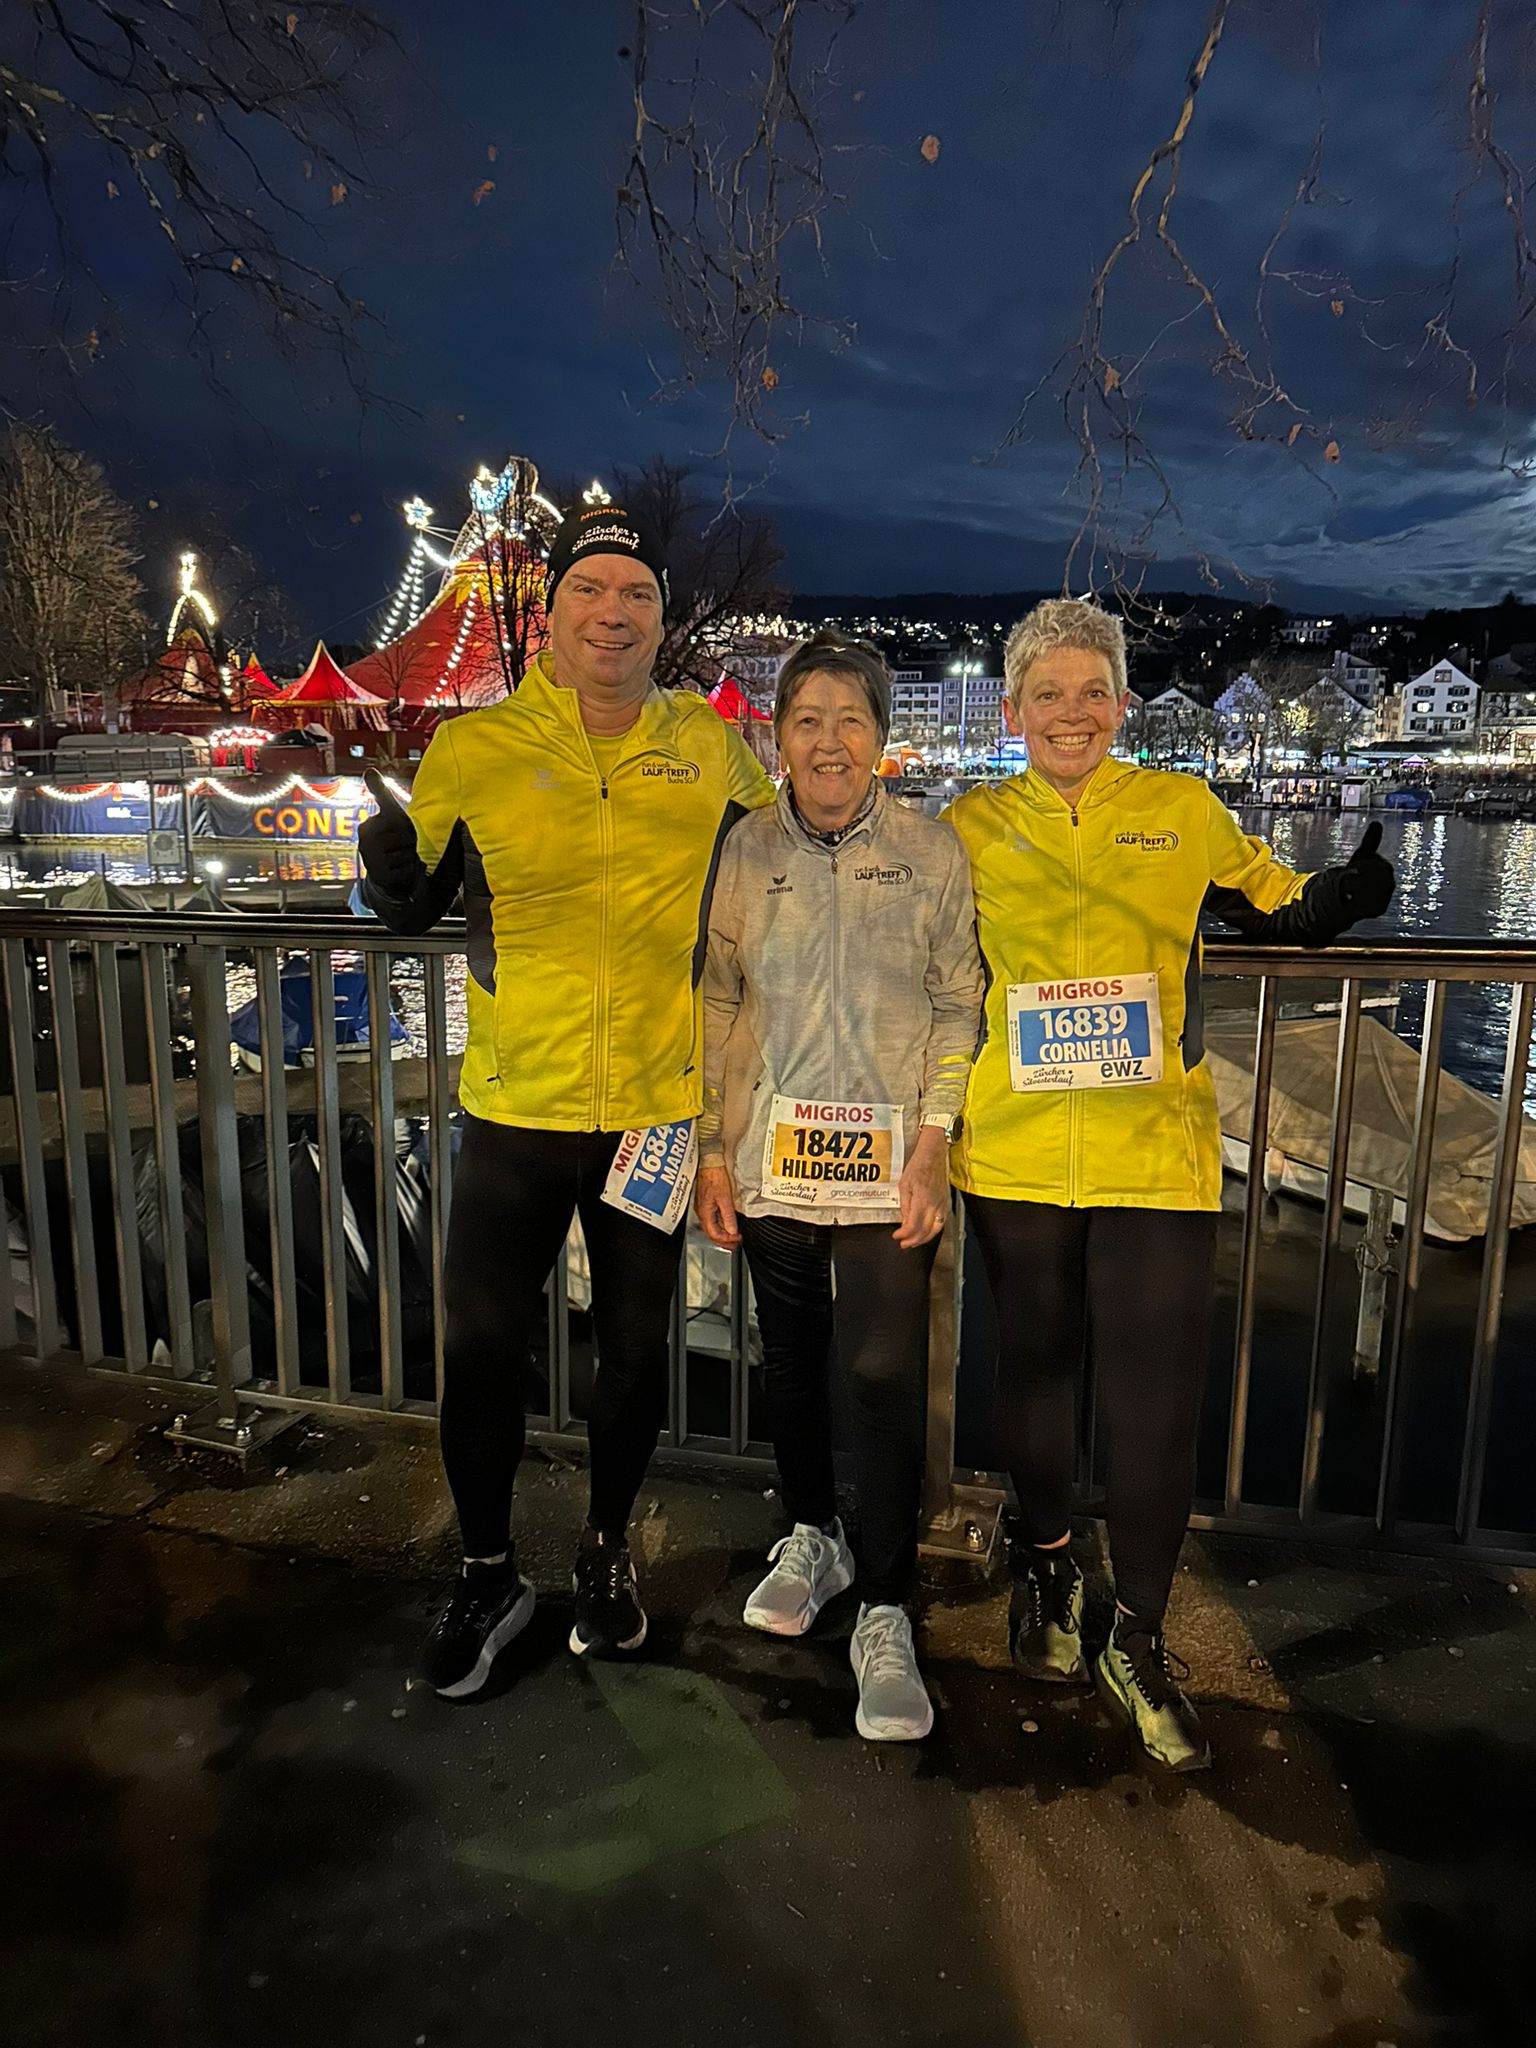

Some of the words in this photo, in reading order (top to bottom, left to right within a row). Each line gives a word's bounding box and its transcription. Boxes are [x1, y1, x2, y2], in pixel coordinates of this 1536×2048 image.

[580, 507, 628, 521] MIGROS
[585, 524, 629, 537] Zürcher
[572, 533, 640, 554] Silvesterlauf
[642, 768, 690, 777] LAUF-TREFF
[1115, 837, 1167, 845] LAUF-TREFF
[855, 870, 901, 880] LAUF-TREFF
[766, 886, 793, 895] erima
[1038, 979, 1123, 1001] MIGROS
[1039, 1004, 1128, 1039] 16839
[1039, 1037, 1132, 1063] CORNELIA
[1033, 1067, 1066, 1078] Zürcher
[1101, 1059, 1143, 1078] ewz
[1022, 1074, 1074, 1086] Silvesterlauf
[794, 1103, 873, 1123] MIGROS
[793, 1128, 873, 1160] 18472
[660, 1126, 689, 1186] MARIO
[781, 1157, 881, 1182] HILDEGARD
[770, 1187, 817, 1204] Silvesterlauf
[780, 1182, 810, 1192] Zürcher
